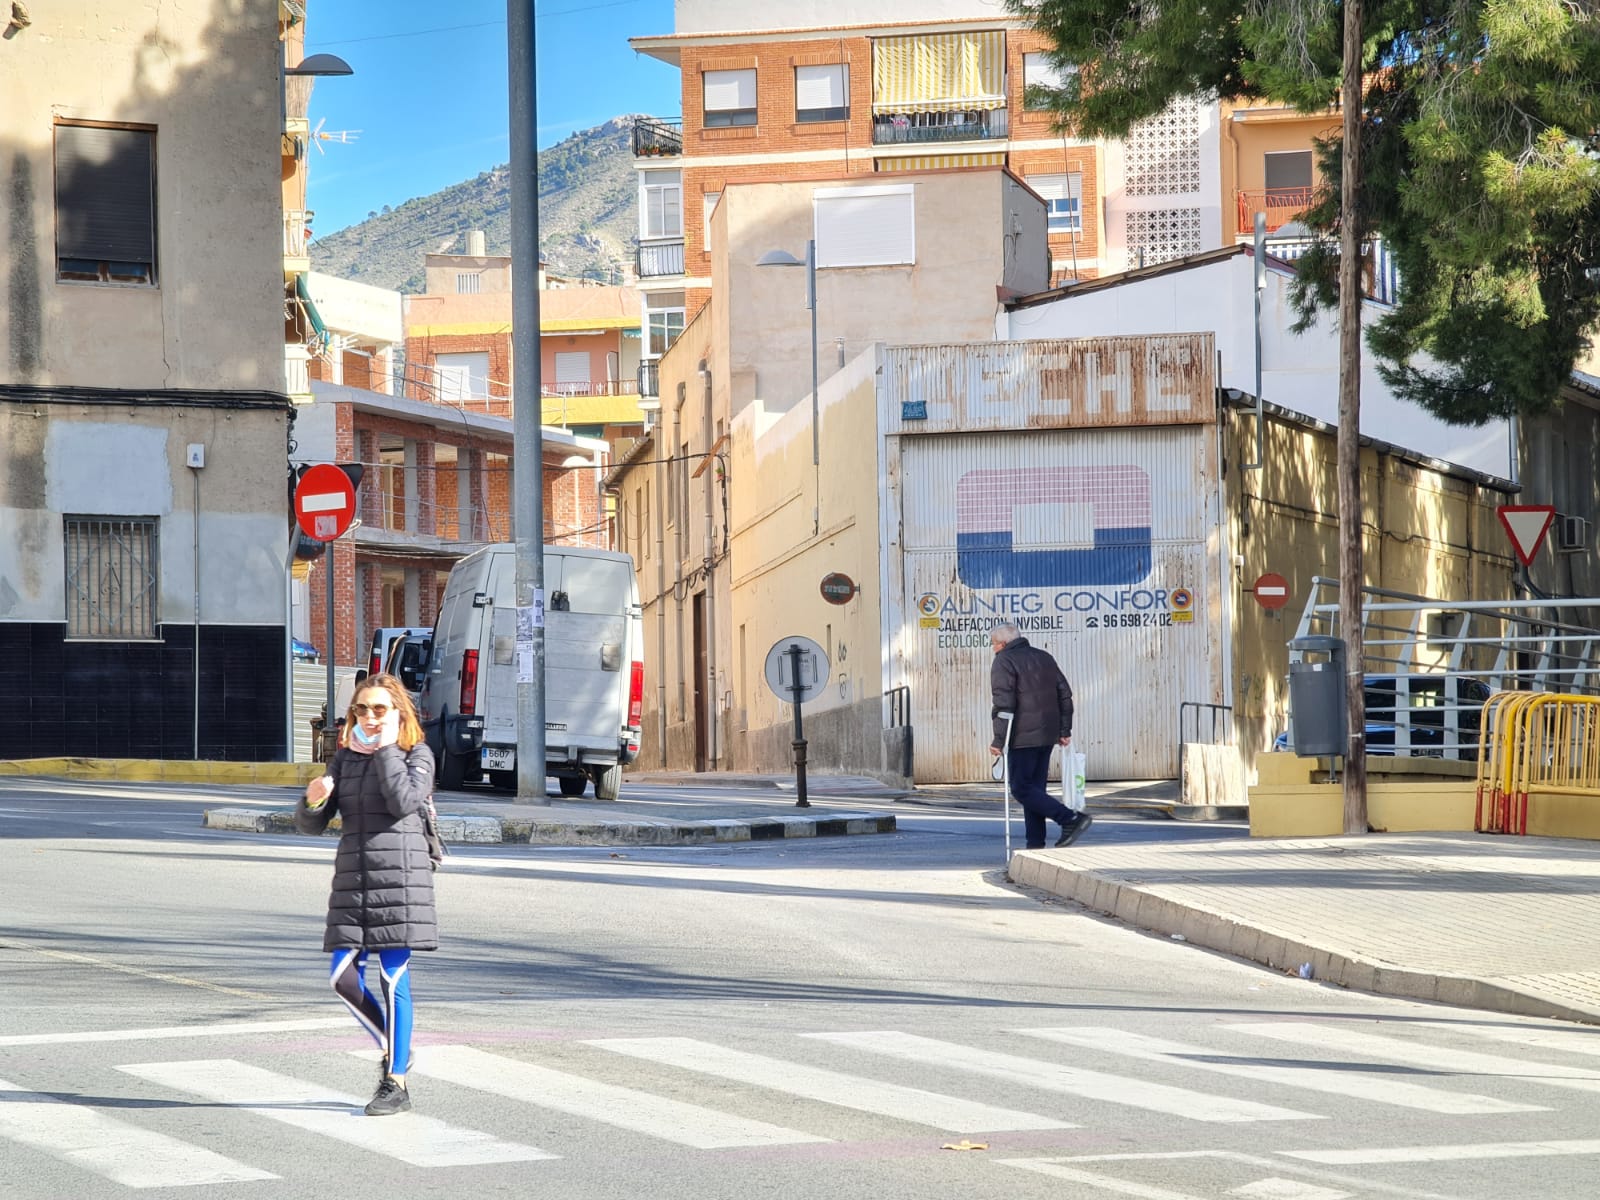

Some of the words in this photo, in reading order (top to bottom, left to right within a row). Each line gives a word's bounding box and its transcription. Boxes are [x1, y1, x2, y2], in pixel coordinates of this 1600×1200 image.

[1054, 589, 1167, 611] CONFOR
[1103, 614, 1118, 628] 96
[1120, 613, 1141, 627] 698
[1159, 612, 1173, 627] 02
